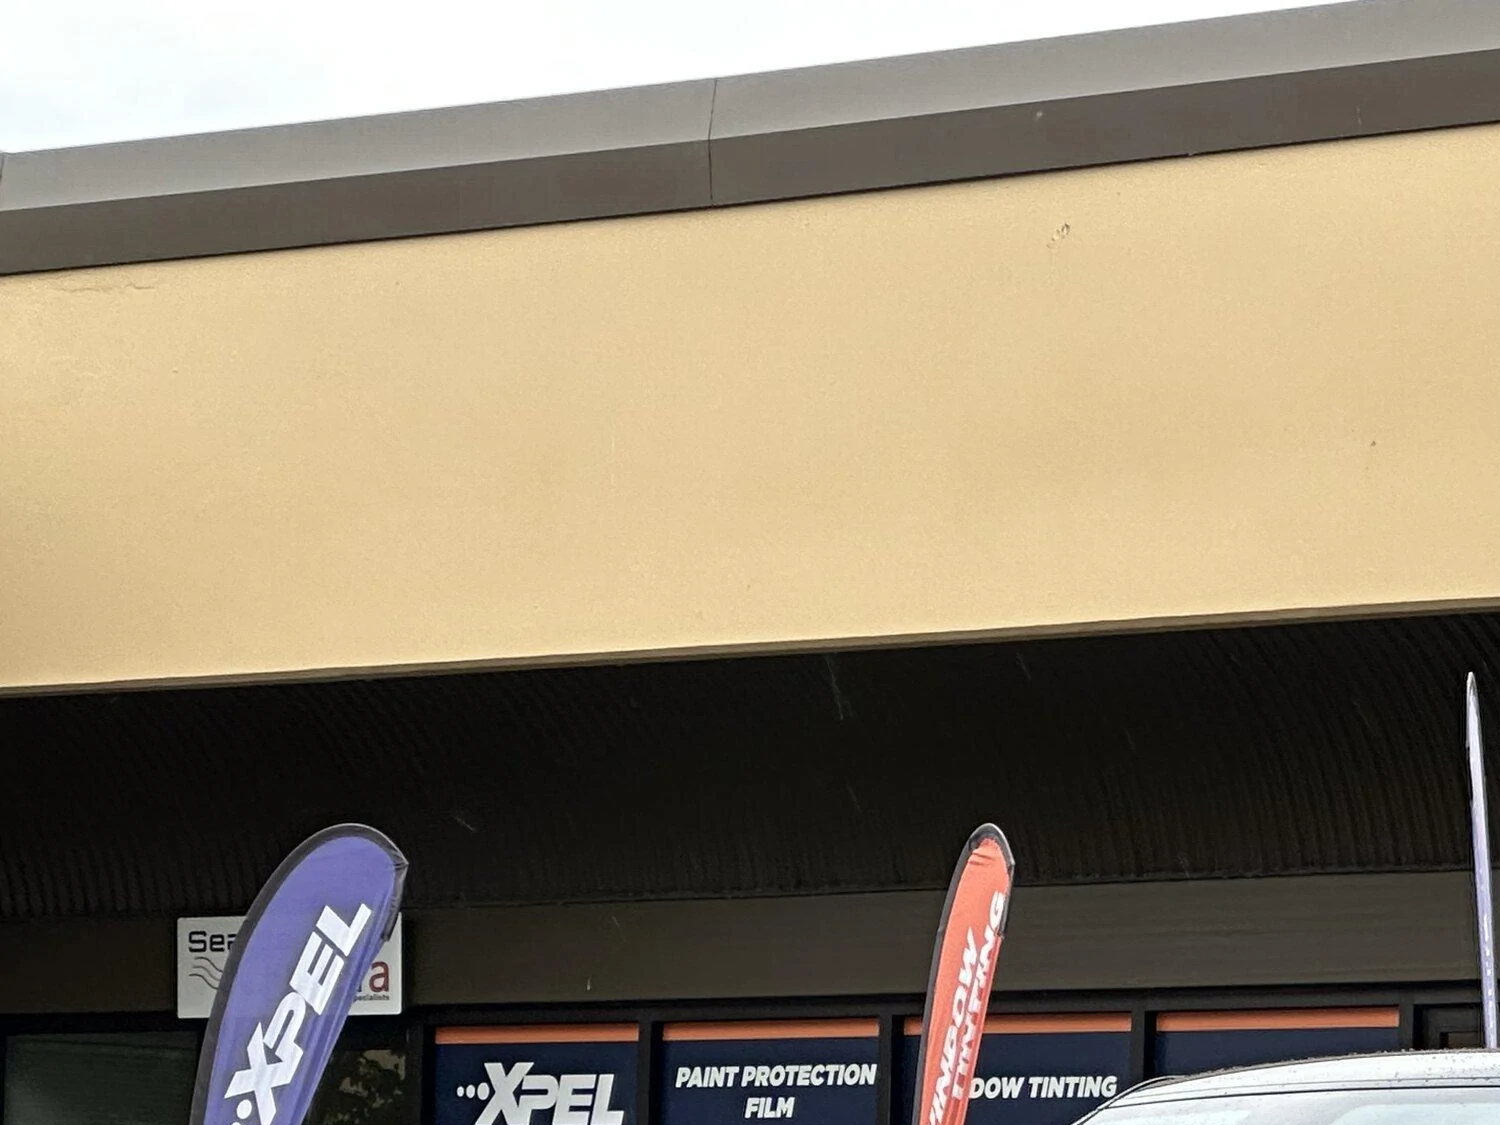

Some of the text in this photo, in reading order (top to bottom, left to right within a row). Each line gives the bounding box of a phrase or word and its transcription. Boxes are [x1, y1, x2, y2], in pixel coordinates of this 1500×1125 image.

[675, 1064, 877, 1088] PAINT PROTECTION
[969, 1075, 1117, 1099] DOW TINTING
[744, 1097, 795, 1119] FILM
